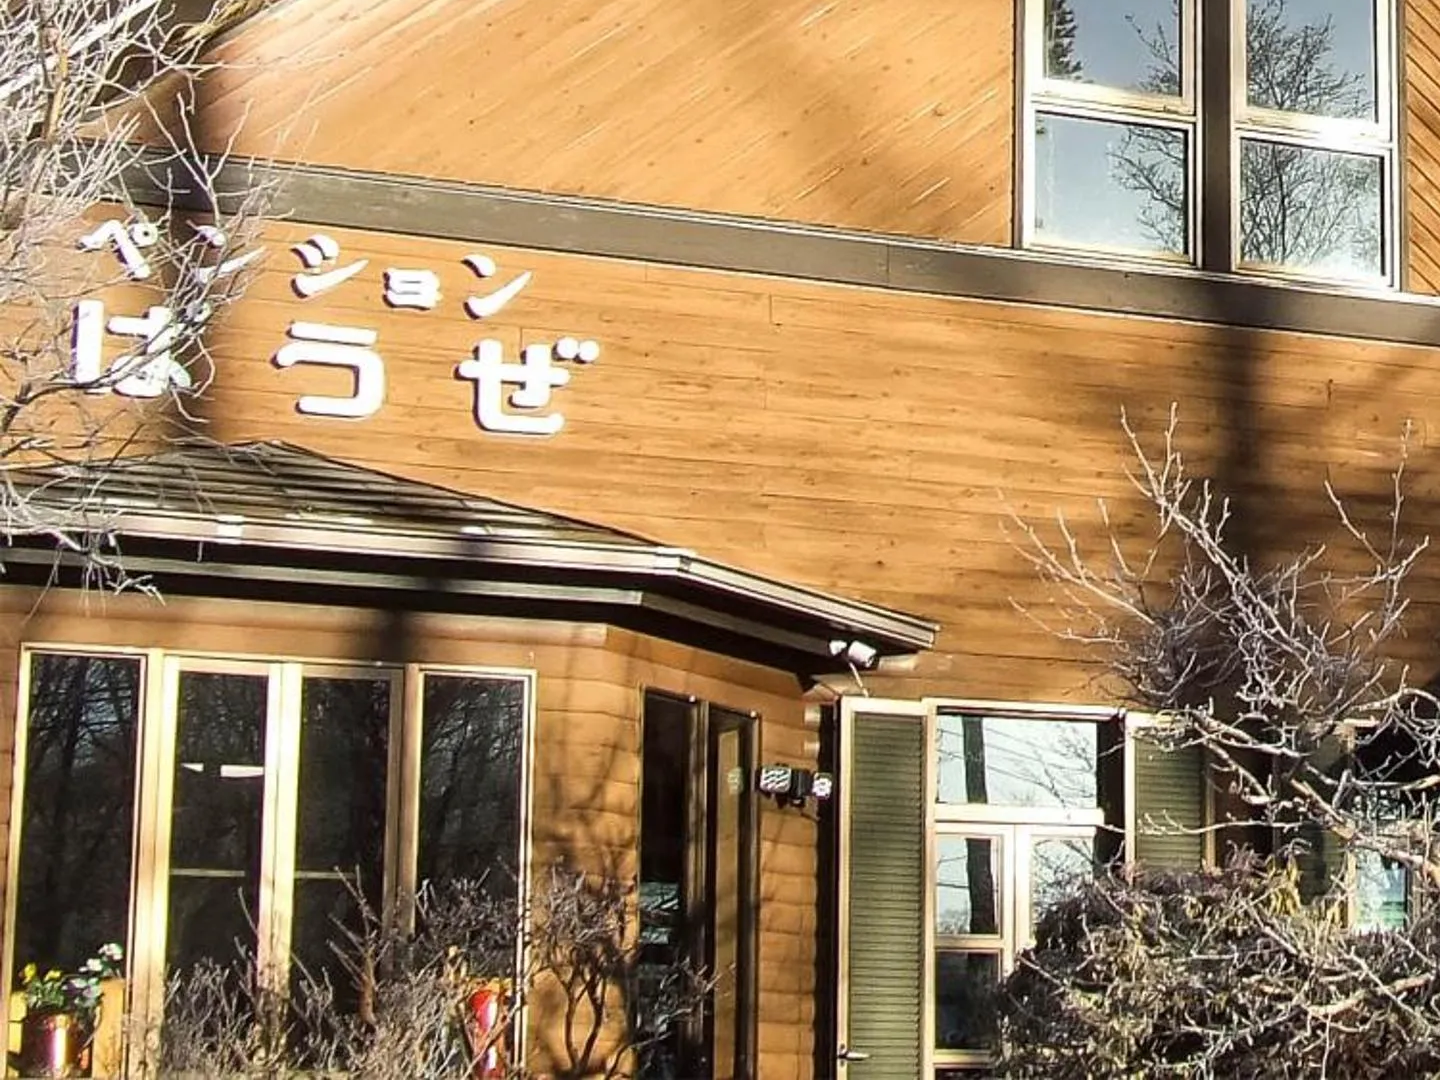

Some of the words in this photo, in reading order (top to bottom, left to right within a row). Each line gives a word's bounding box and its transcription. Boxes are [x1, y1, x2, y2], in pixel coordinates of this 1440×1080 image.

[75, 220, 533, 319] ペンション
